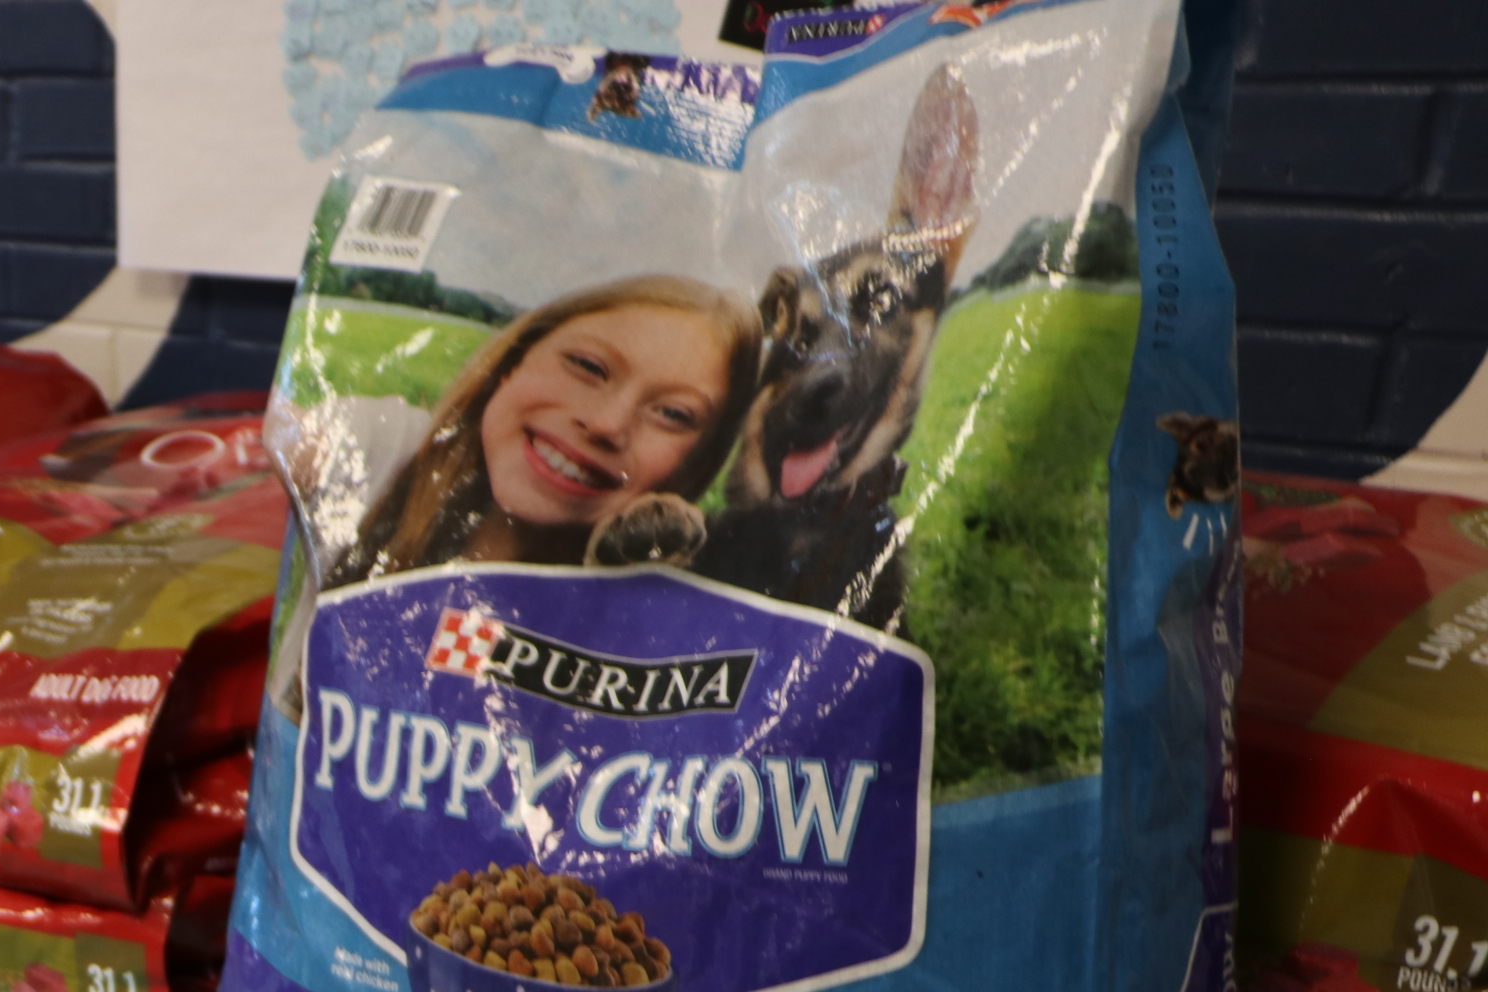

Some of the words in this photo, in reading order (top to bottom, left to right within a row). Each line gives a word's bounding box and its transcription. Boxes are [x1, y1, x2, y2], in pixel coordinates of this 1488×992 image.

[789, 19, 866, 42] PURINA
[29, 672, 88, 701] ADULT
[112, 674, 161, 704] FOOD
[504, 641, 734, 712] PURINA
[315, 688, 580, 832] PUPPY
[575, 752, 879, 866] CHOW
[1210, 670, 1239, 845] Large
[363, 950, 392, 976] with
